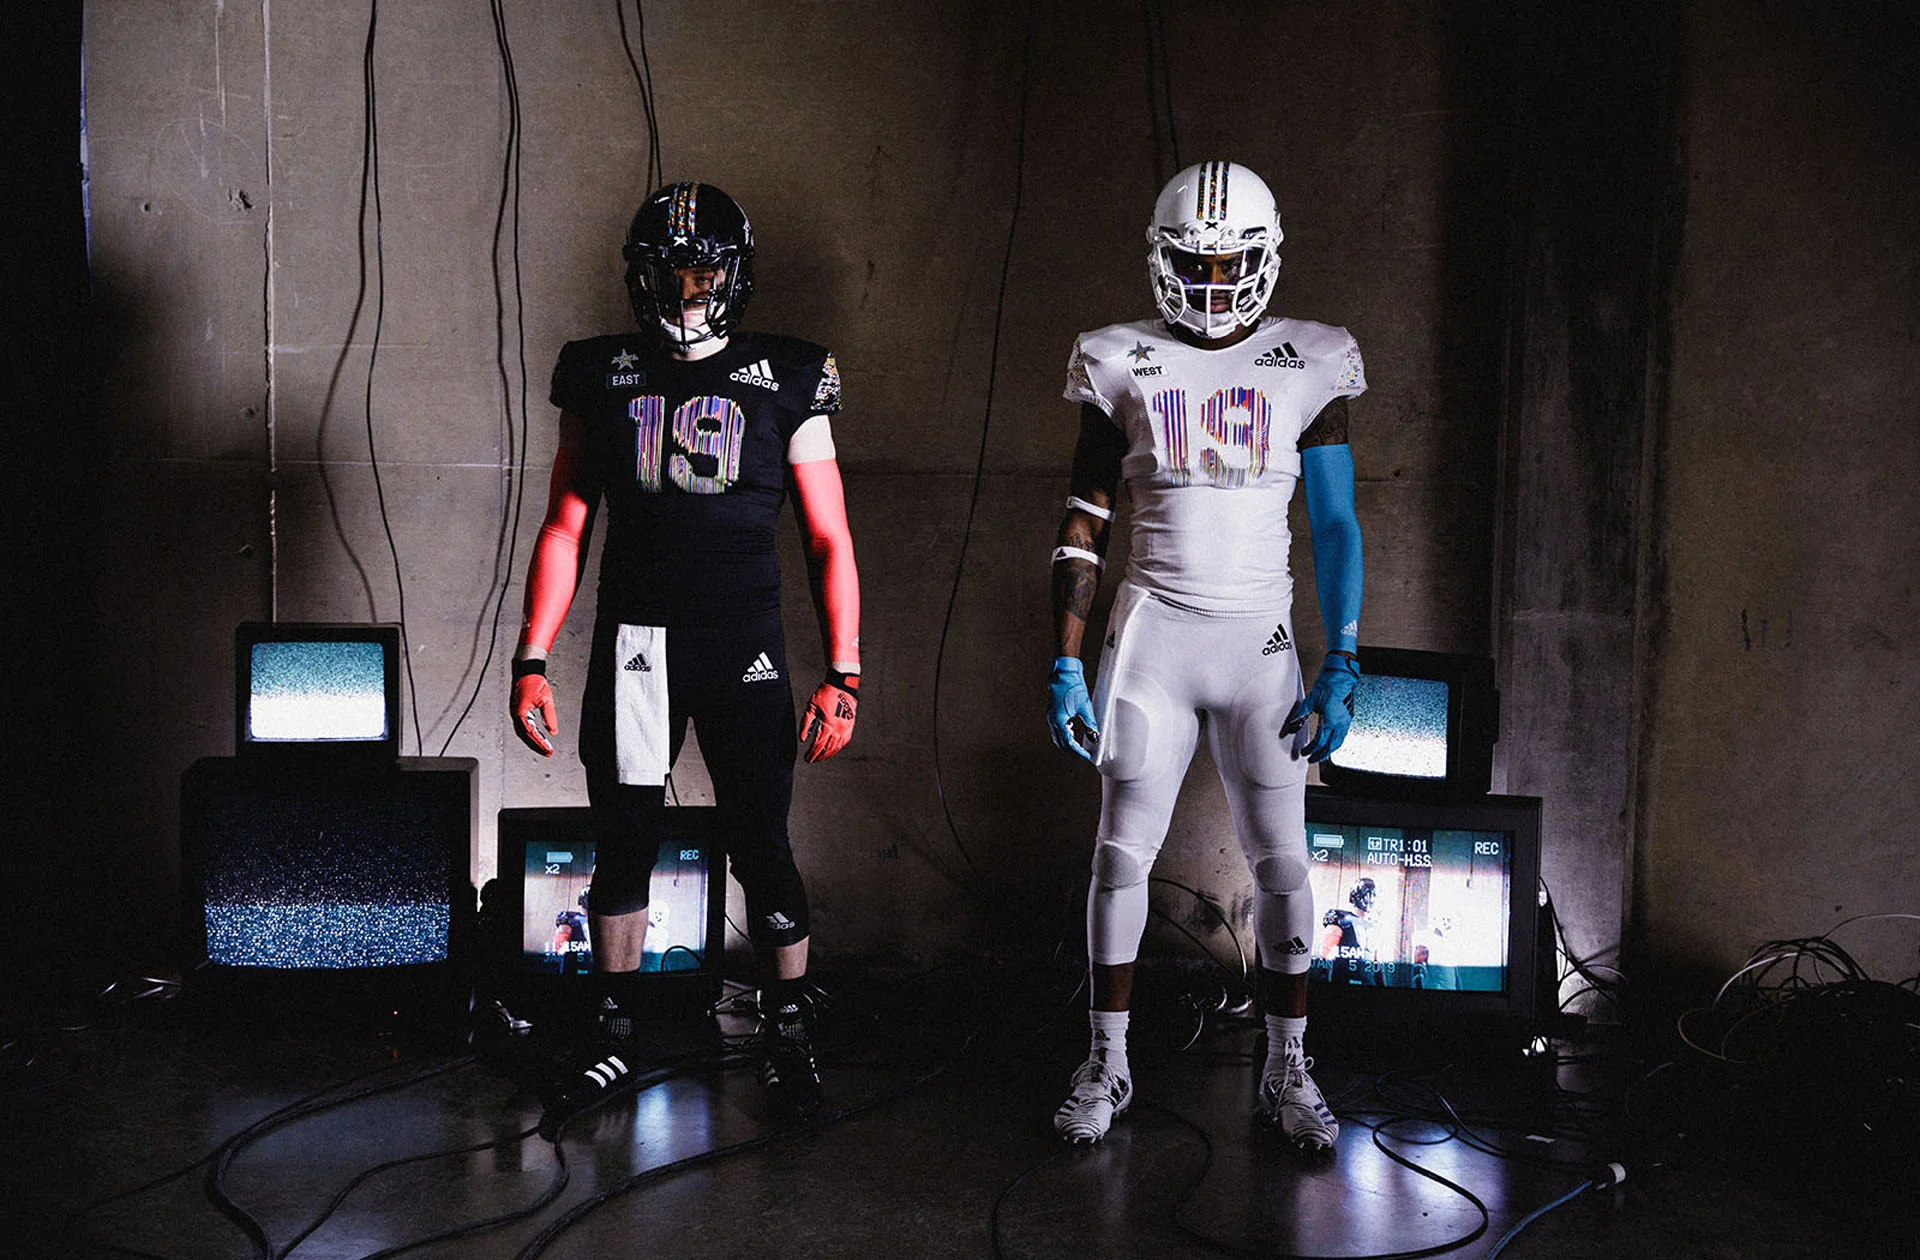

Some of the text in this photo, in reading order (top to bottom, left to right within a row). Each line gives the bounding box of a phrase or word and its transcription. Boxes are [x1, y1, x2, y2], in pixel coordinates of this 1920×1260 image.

[1254, 356, 1306, 370] adidas
[1132, 366, 1162, 377] WEST
[612, 373, 640, 386] EAST
[729, 372, 780, 392] adidas
[1153, 386, 1271, 488] 19
[628, 394, 745, 494] 19
[742, 669, 779, 682] adidas
[679, 849, 699, 860] REC
[1474, 841, 1499, 855] REC
[1348, 959, 1358, 972] 5
